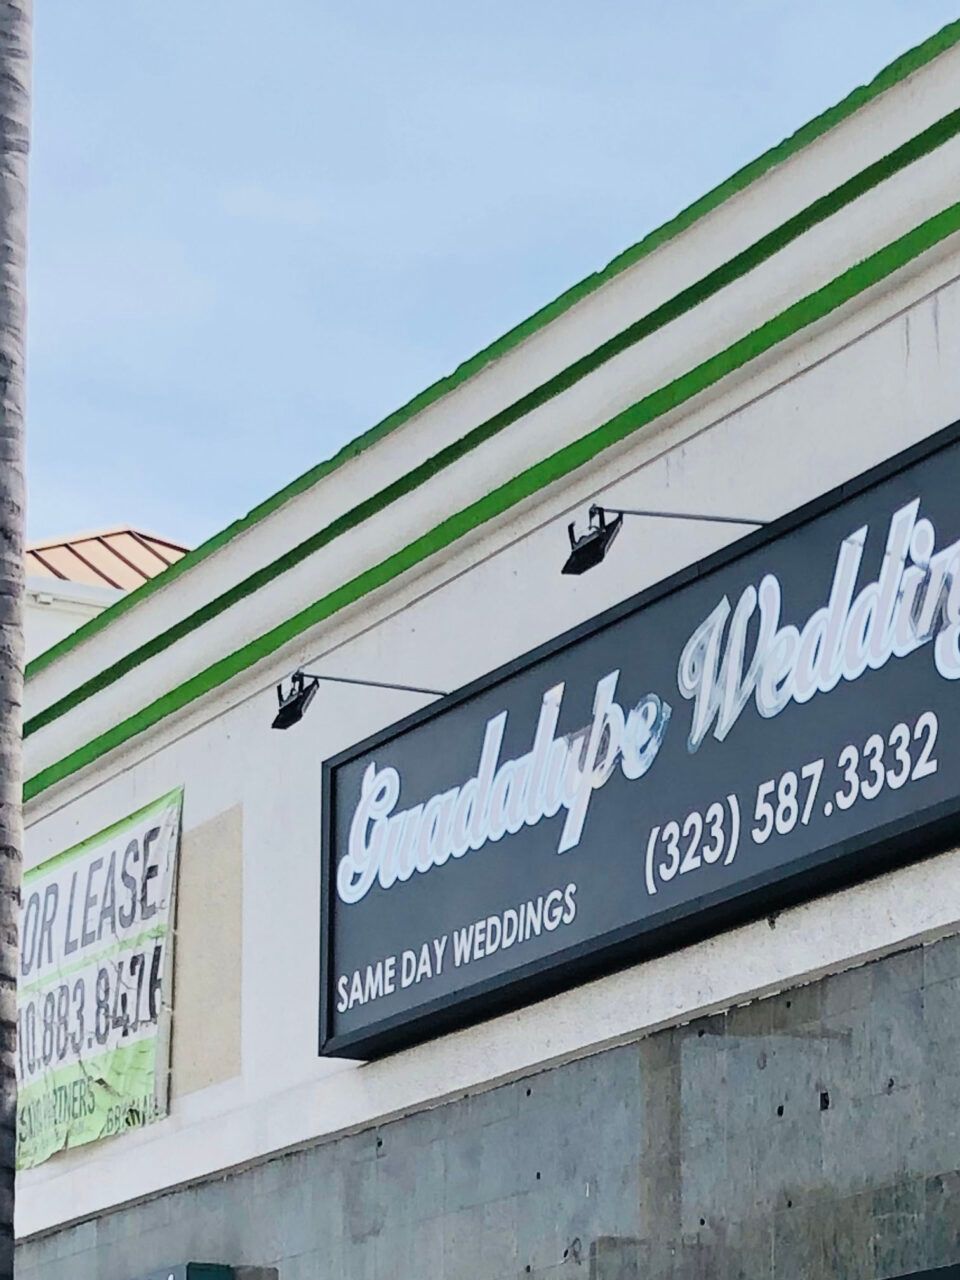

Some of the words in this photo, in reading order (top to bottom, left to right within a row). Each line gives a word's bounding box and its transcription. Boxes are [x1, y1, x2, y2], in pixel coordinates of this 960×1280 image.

[336, 668, 672, 904] Guadalupe
[645, 795, 741, 894] (323)
[752, 711, 940, 845] 587.3332
[20, 883, 59, 976] OR
[64, 826, 161, 956] LEASE
[336, 961, 395, 1013] SAME
[400, 933, 449, 986] DAY
[452, 883, 578, 967] WEDDINGS
